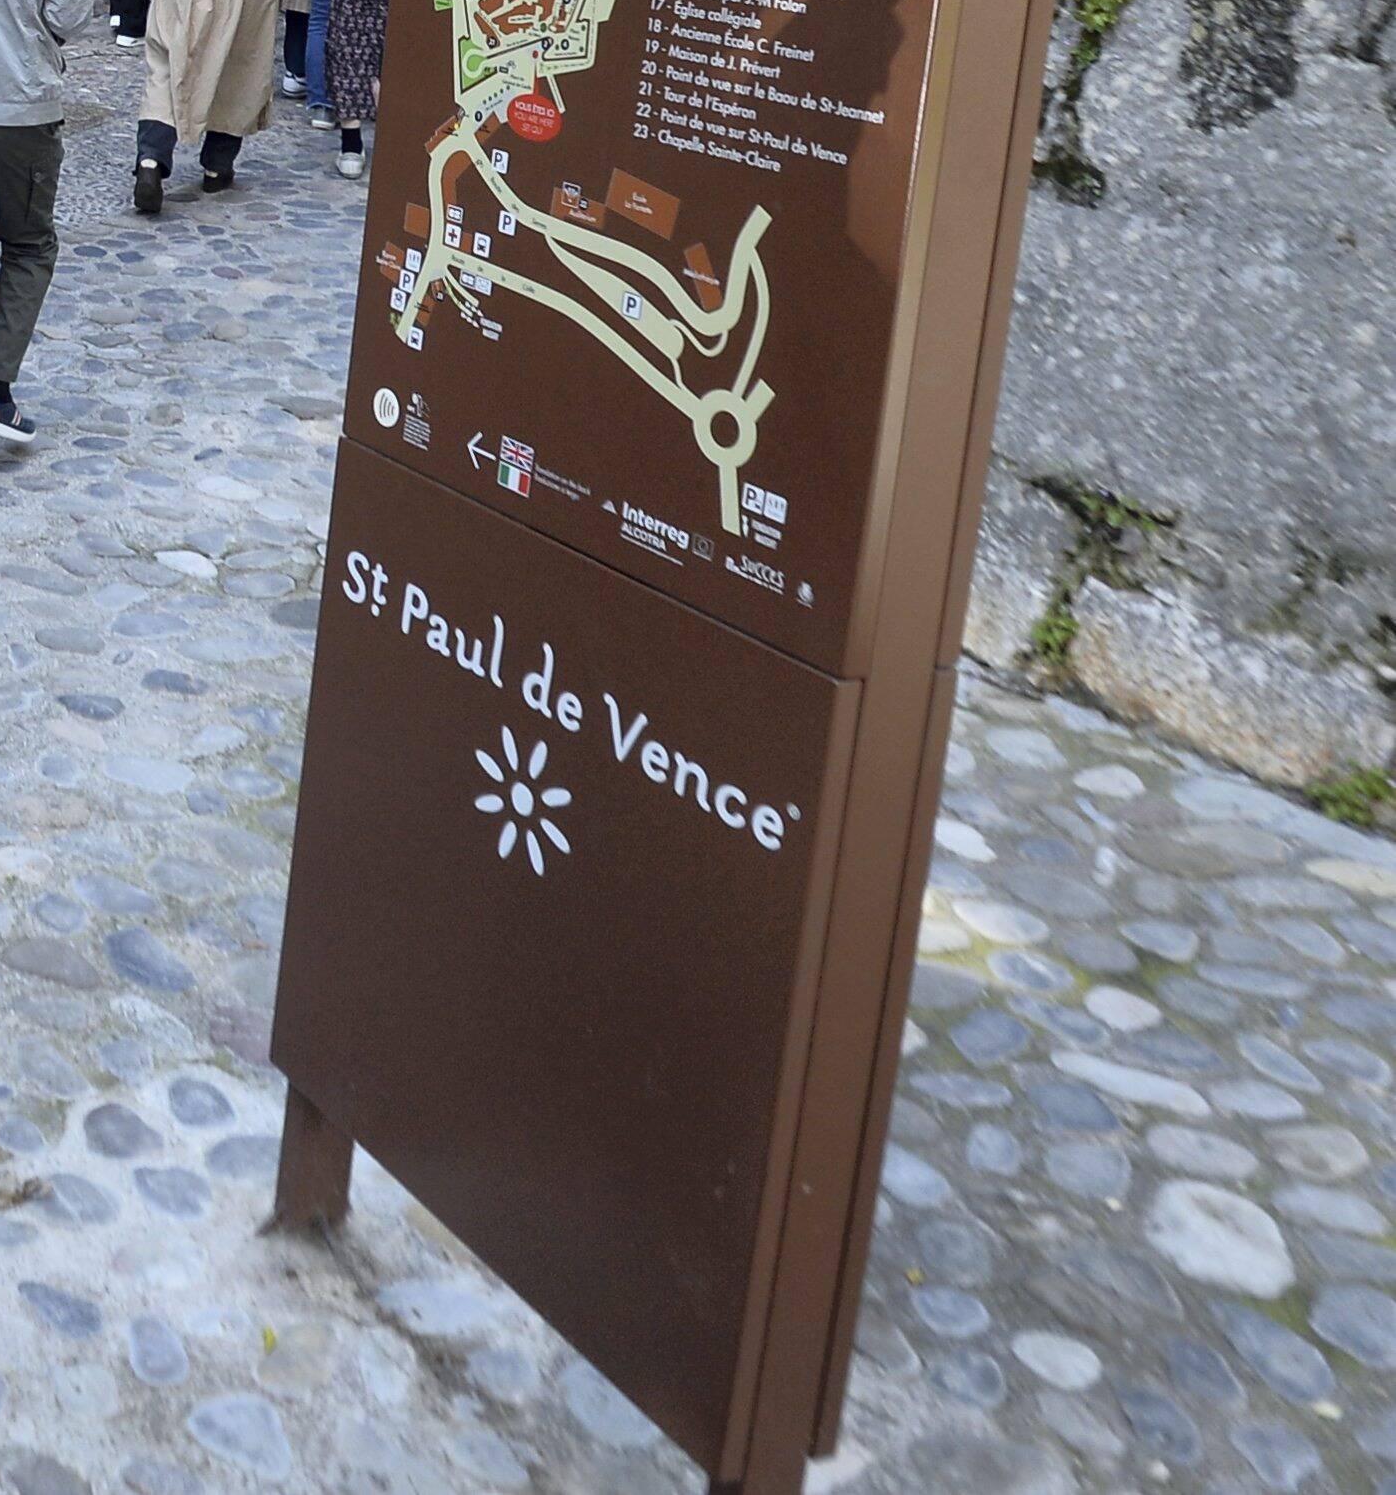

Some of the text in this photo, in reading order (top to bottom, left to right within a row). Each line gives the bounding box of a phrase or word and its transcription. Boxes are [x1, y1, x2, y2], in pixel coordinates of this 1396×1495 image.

[647, 18, 662, 33] 18
[671, 23, 722, 45] Ancienne
[645, 39, 659, 53] 19
[668, 44, 707, 64] Maison
[710, 49, 725, 68] de
[639, 81, 652, 96] 21
[664, 86, 686, 104] Tour
[688, 91, 703, 108] de
[641, 60, 657, 75] 20
[666, 65, 693, 84] Point
[695, 70, 709, 87] de
[711, 78, 732, 91] vue
[734, 83, 752, 96] sur
[801, 93, 817, 111] de
[633, 124, 649, 139] 23
[658, 128, 706, 153] Chapelle
[636, 103, 848, 165] 22 Point de vue sur St-Paul de Vence
[622, 501, 689, 550] Interreg
[341, 550, 389, 618] St
[400, 582, 503, 688] Paul
[522, 642, 582, 732] de
